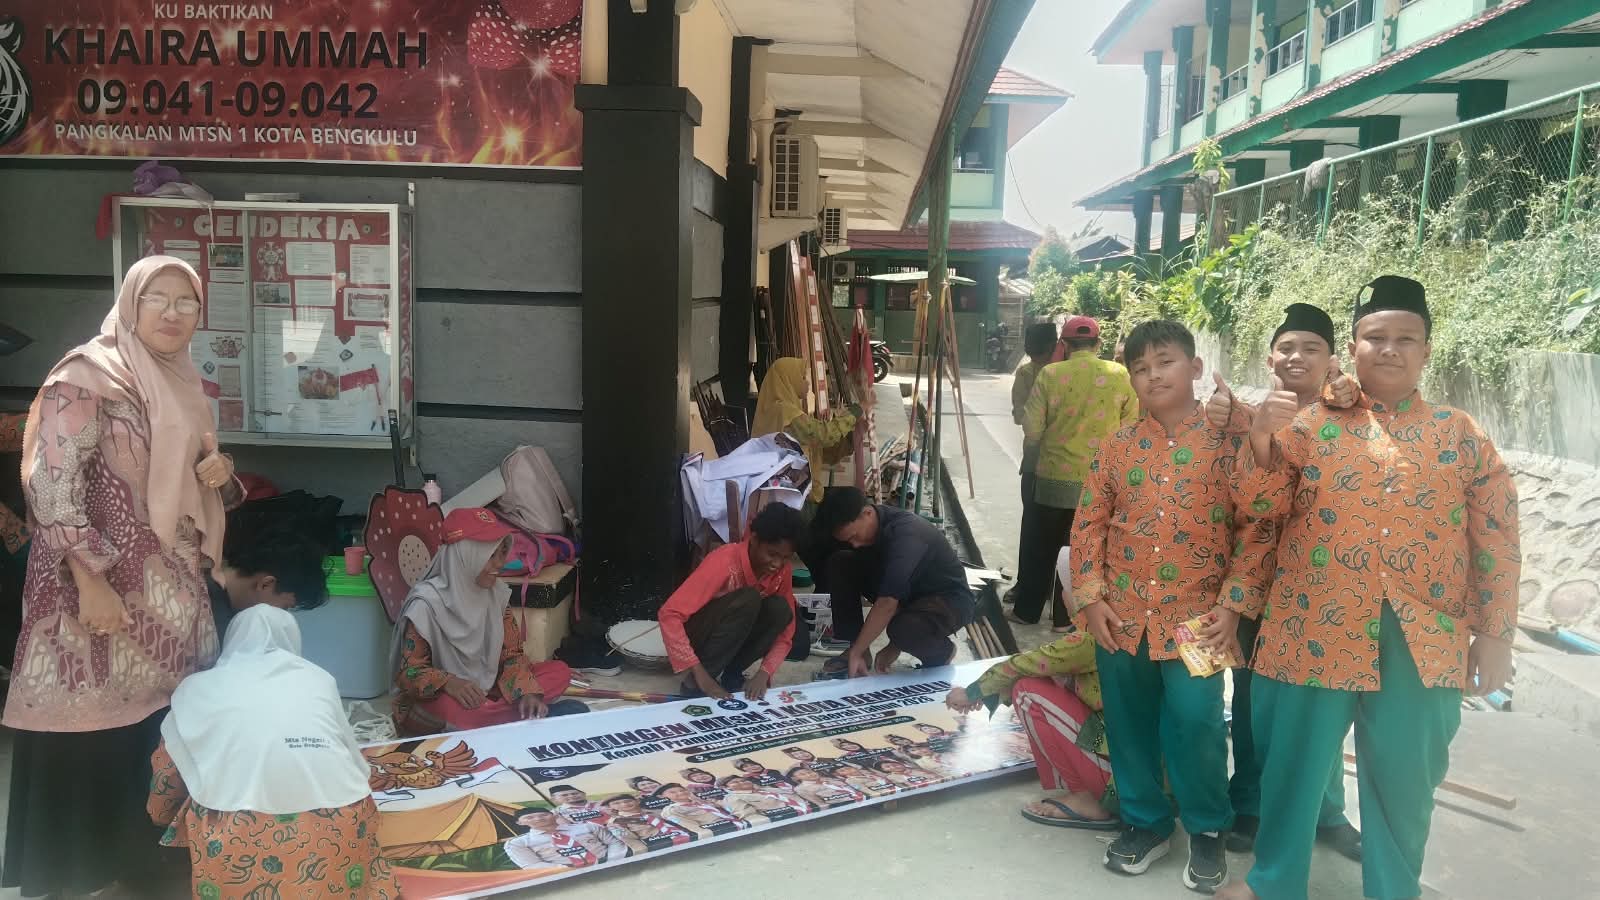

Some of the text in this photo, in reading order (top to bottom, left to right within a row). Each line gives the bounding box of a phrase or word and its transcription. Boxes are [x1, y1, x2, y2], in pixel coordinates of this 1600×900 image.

[155, 4, 273, 20] KU BAKTIKAN
[45, 28, 427, 68] KHAIRA UMMAH
[77, 78, 379, 119] 09.041-09.042
[55, 123, 417, 146] PANGKALAN MTSN 1 KOTA BENGKULU
[528, 722, 697, 762] KONTINGEN
[779, 699, 852, 717] KOTA
[840, 680, 952, 707] BENGKULU
[601, 743, 663, 761] Kemah
[661, 730, 738, 749] Pramuka
[733, 717, 813, 735] Madrasah
